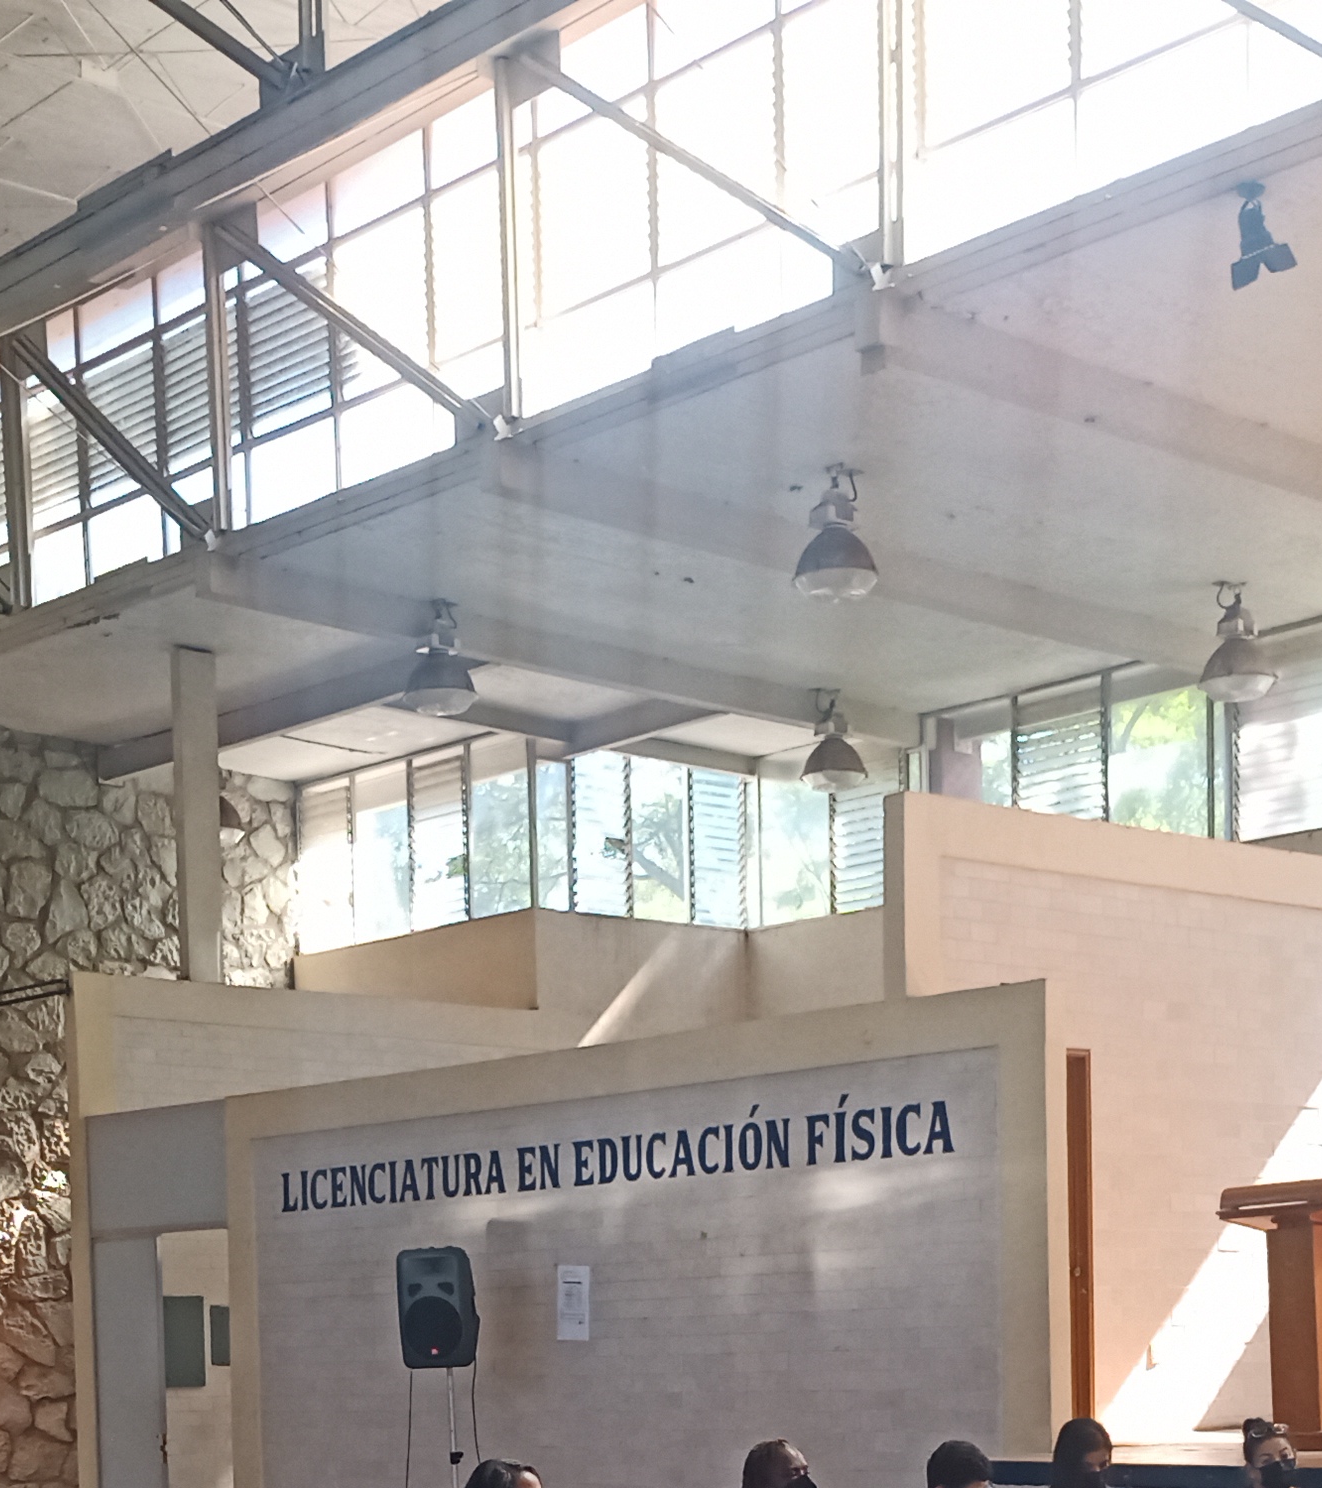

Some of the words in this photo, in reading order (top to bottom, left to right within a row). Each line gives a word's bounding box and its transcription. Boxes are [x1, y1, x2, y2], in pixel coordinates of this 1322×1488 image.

[280, 1151, 507, 1213] LICENCIATURA
[516, 1143, 561, 1195] EN
[572, 1104, 792, 1187] EDUCACIÓN
[805, 1093, 955, 1168] FÍSICA
